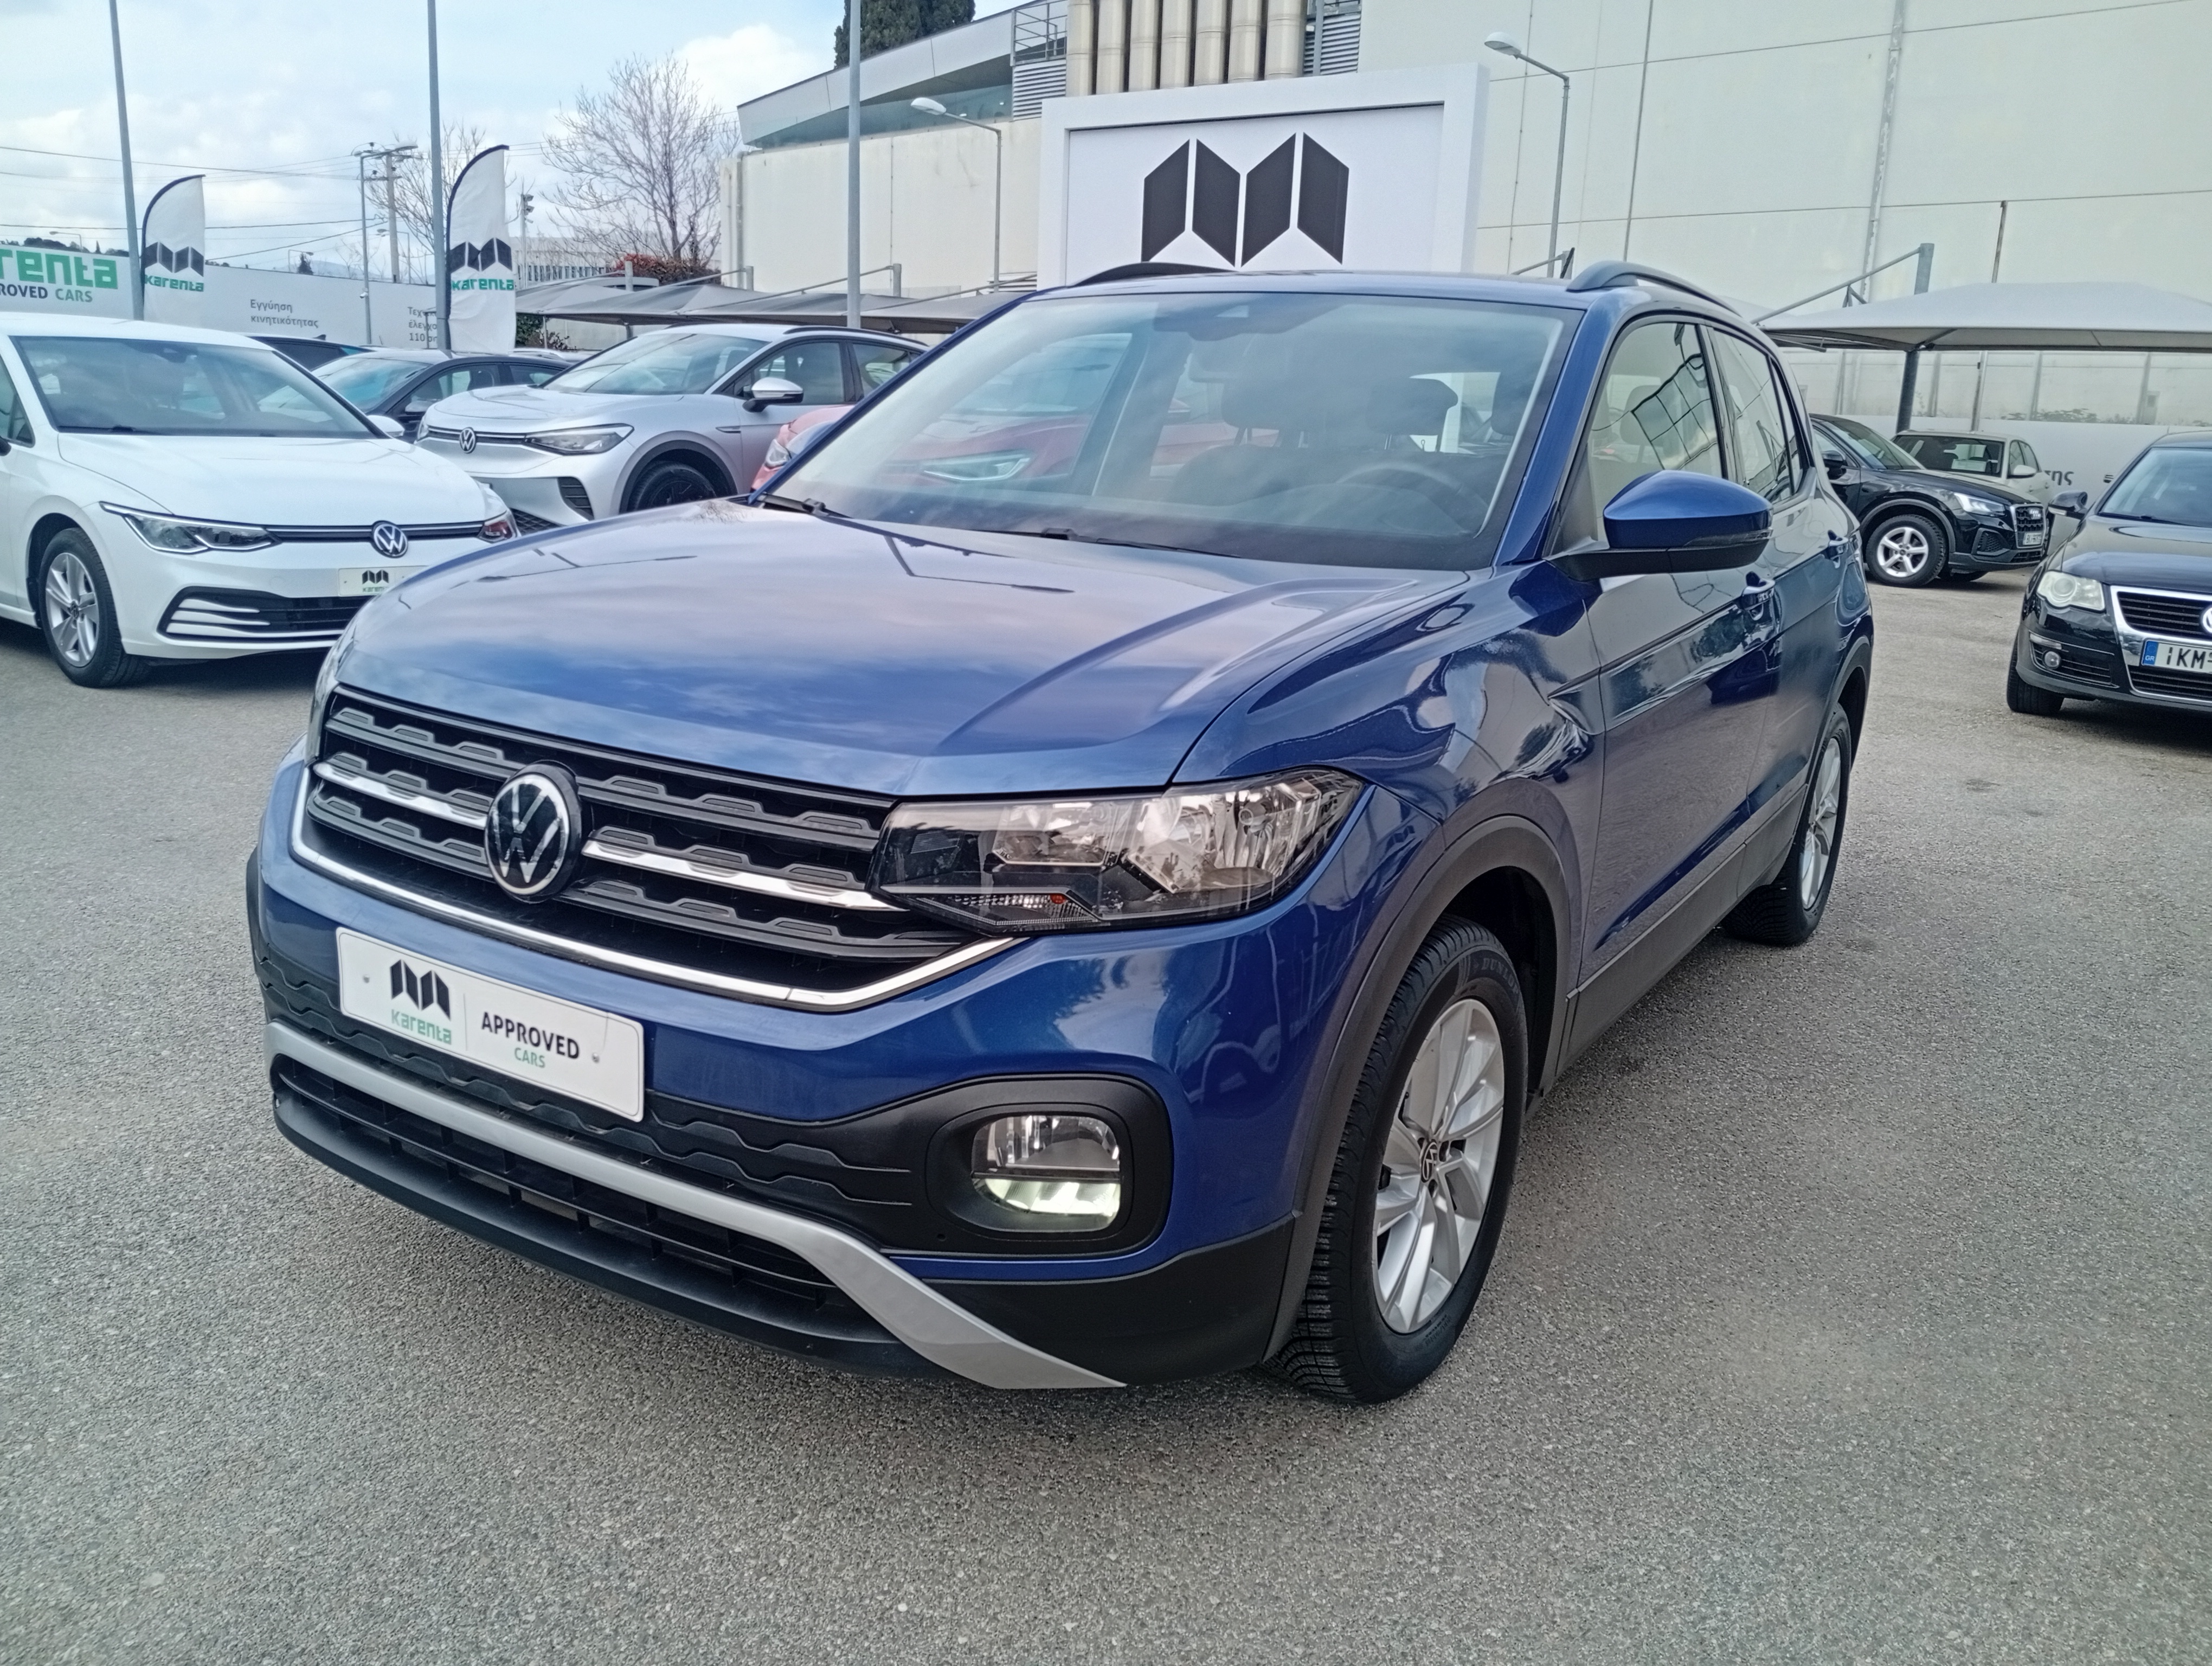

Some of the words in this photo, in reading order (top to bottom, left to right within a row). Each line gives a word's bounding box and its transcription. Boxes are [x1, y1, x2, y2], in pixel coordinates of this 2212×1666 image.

[55, 288, 93, 303] CARS
[250, 299, 292, 314] Εγγύηση
[250, 316, 319, 329] κινητικότητας
[409, 332, 425, 342] 110
[481, 1011, 580, 1059] APPROVED
[514, 1047, 546, 1068] CARS
